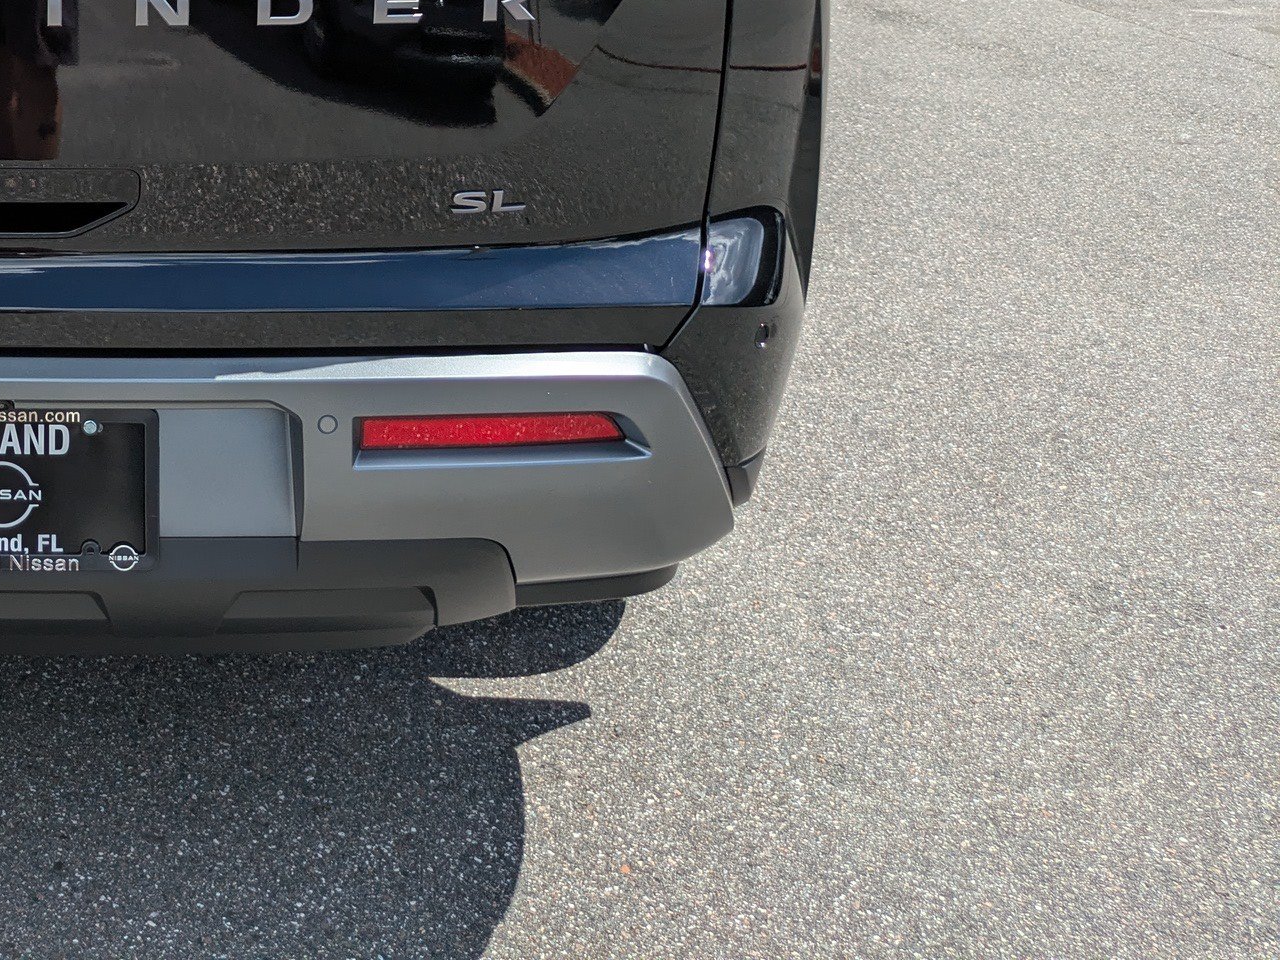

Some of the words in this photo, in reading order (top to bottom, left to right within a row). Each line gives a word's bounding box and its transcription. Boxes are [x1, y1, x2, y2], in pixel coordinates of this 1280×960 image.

[449, 189, 527, 214] SL
[37, 534, 64, 553] FL
[9, 554, 80, 571] Nissan
